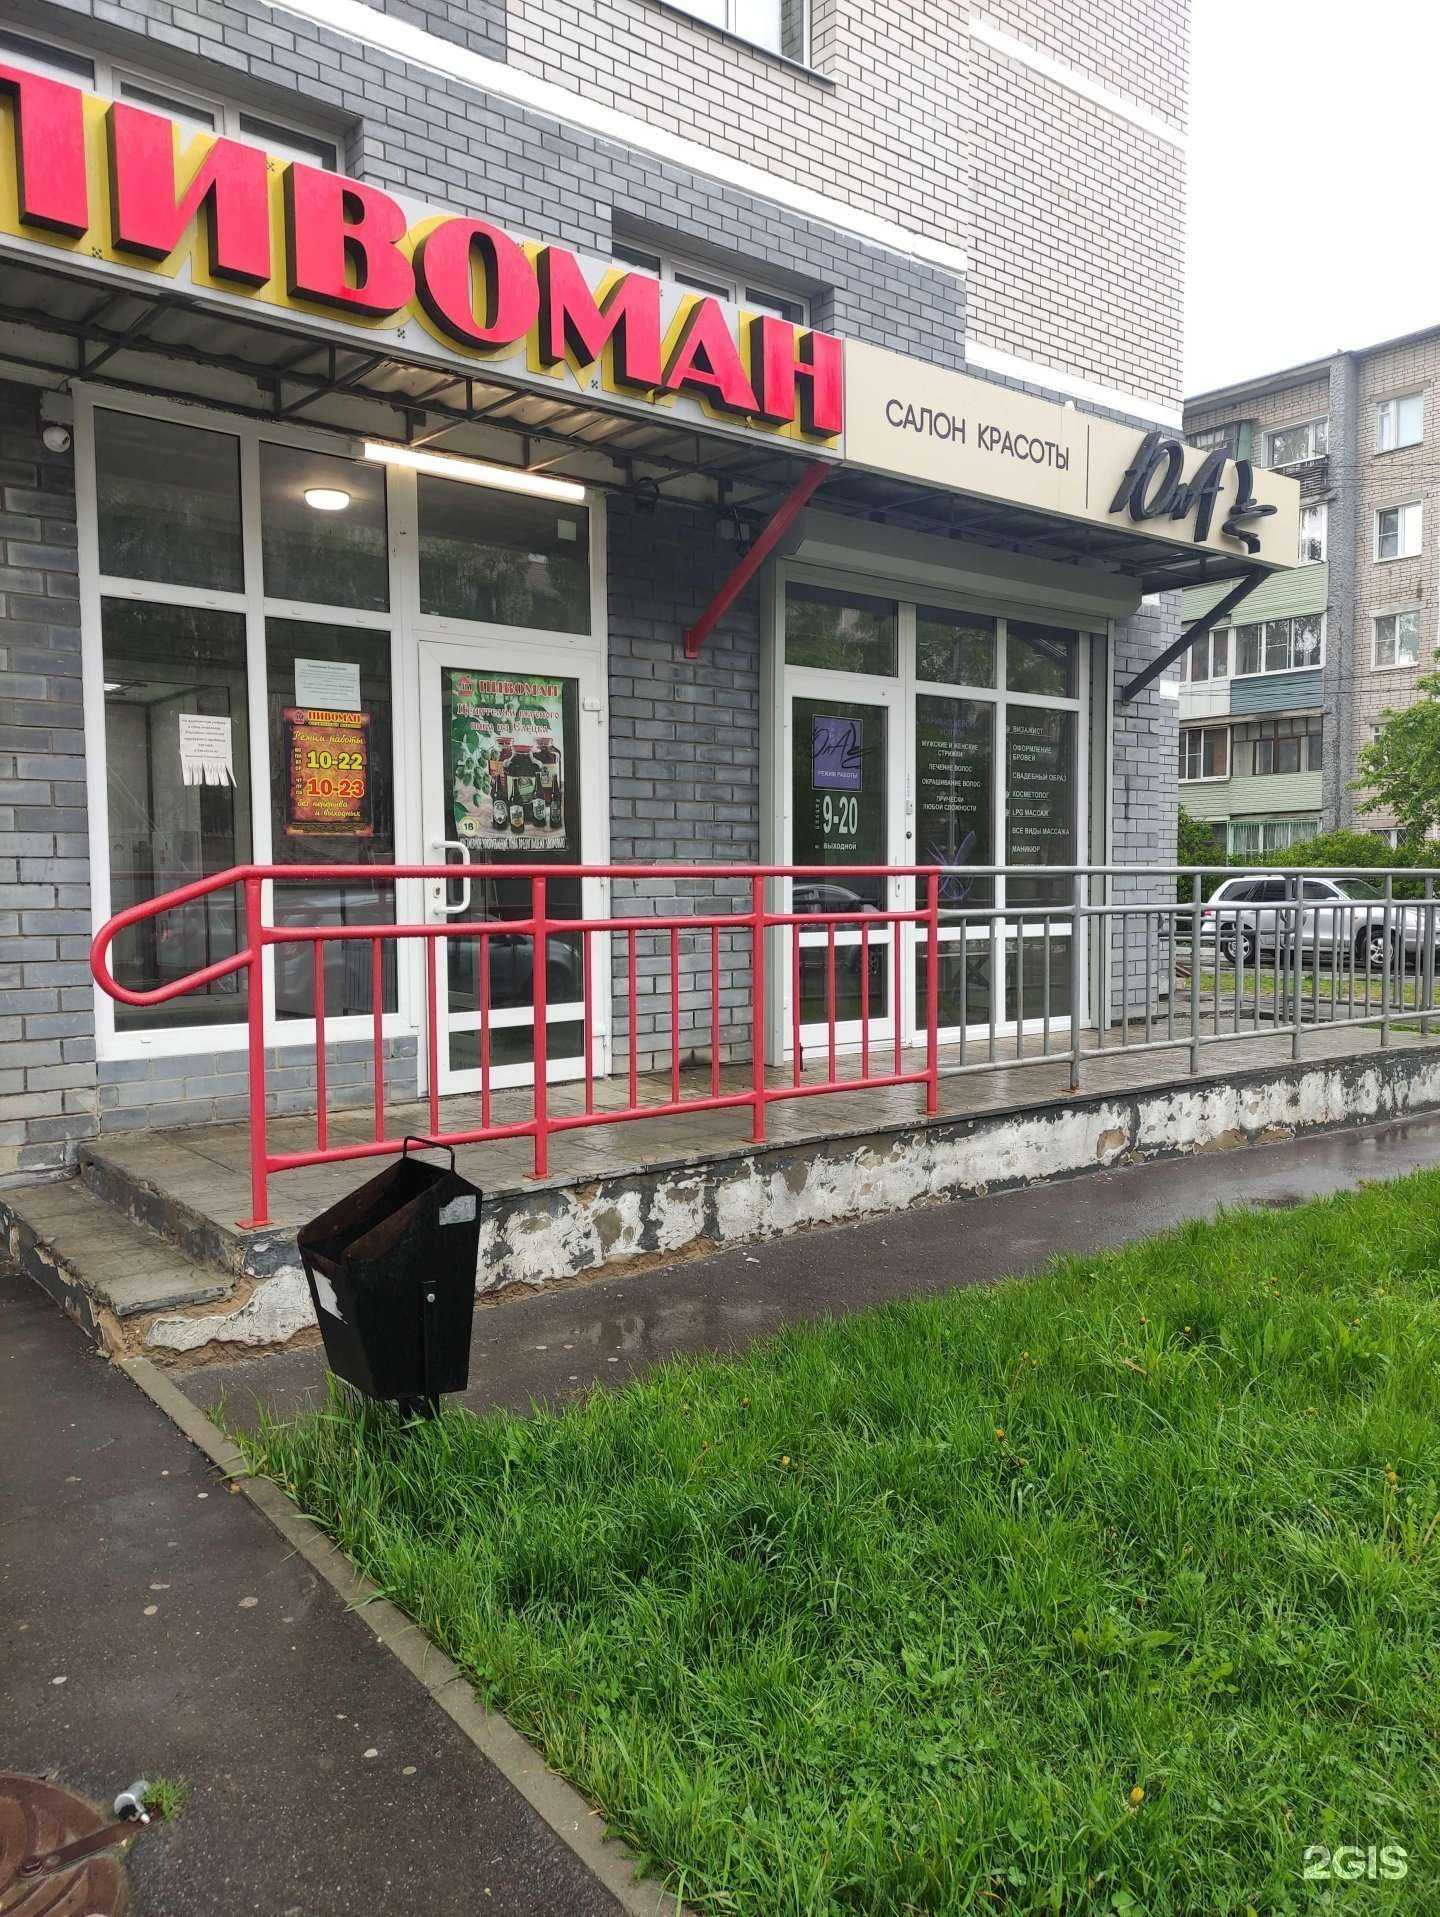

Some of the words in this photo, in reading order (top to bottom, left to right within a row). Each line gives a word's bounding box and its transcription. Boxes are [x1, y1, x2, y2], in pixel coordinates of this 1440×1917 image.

[885, 398, 966, 444] САЛОН
[977, 422, 1070, 471] КРАСОТЫ
[306, 750, 363, 770] 10-22
[306, 777, 365, 798] 10-23
[822, 795, 858, 835] 9-20
[1024, 809, 1050, 817] МАССАЖ
[823, 841, 857, 850] ВЫХОДНОЙ
